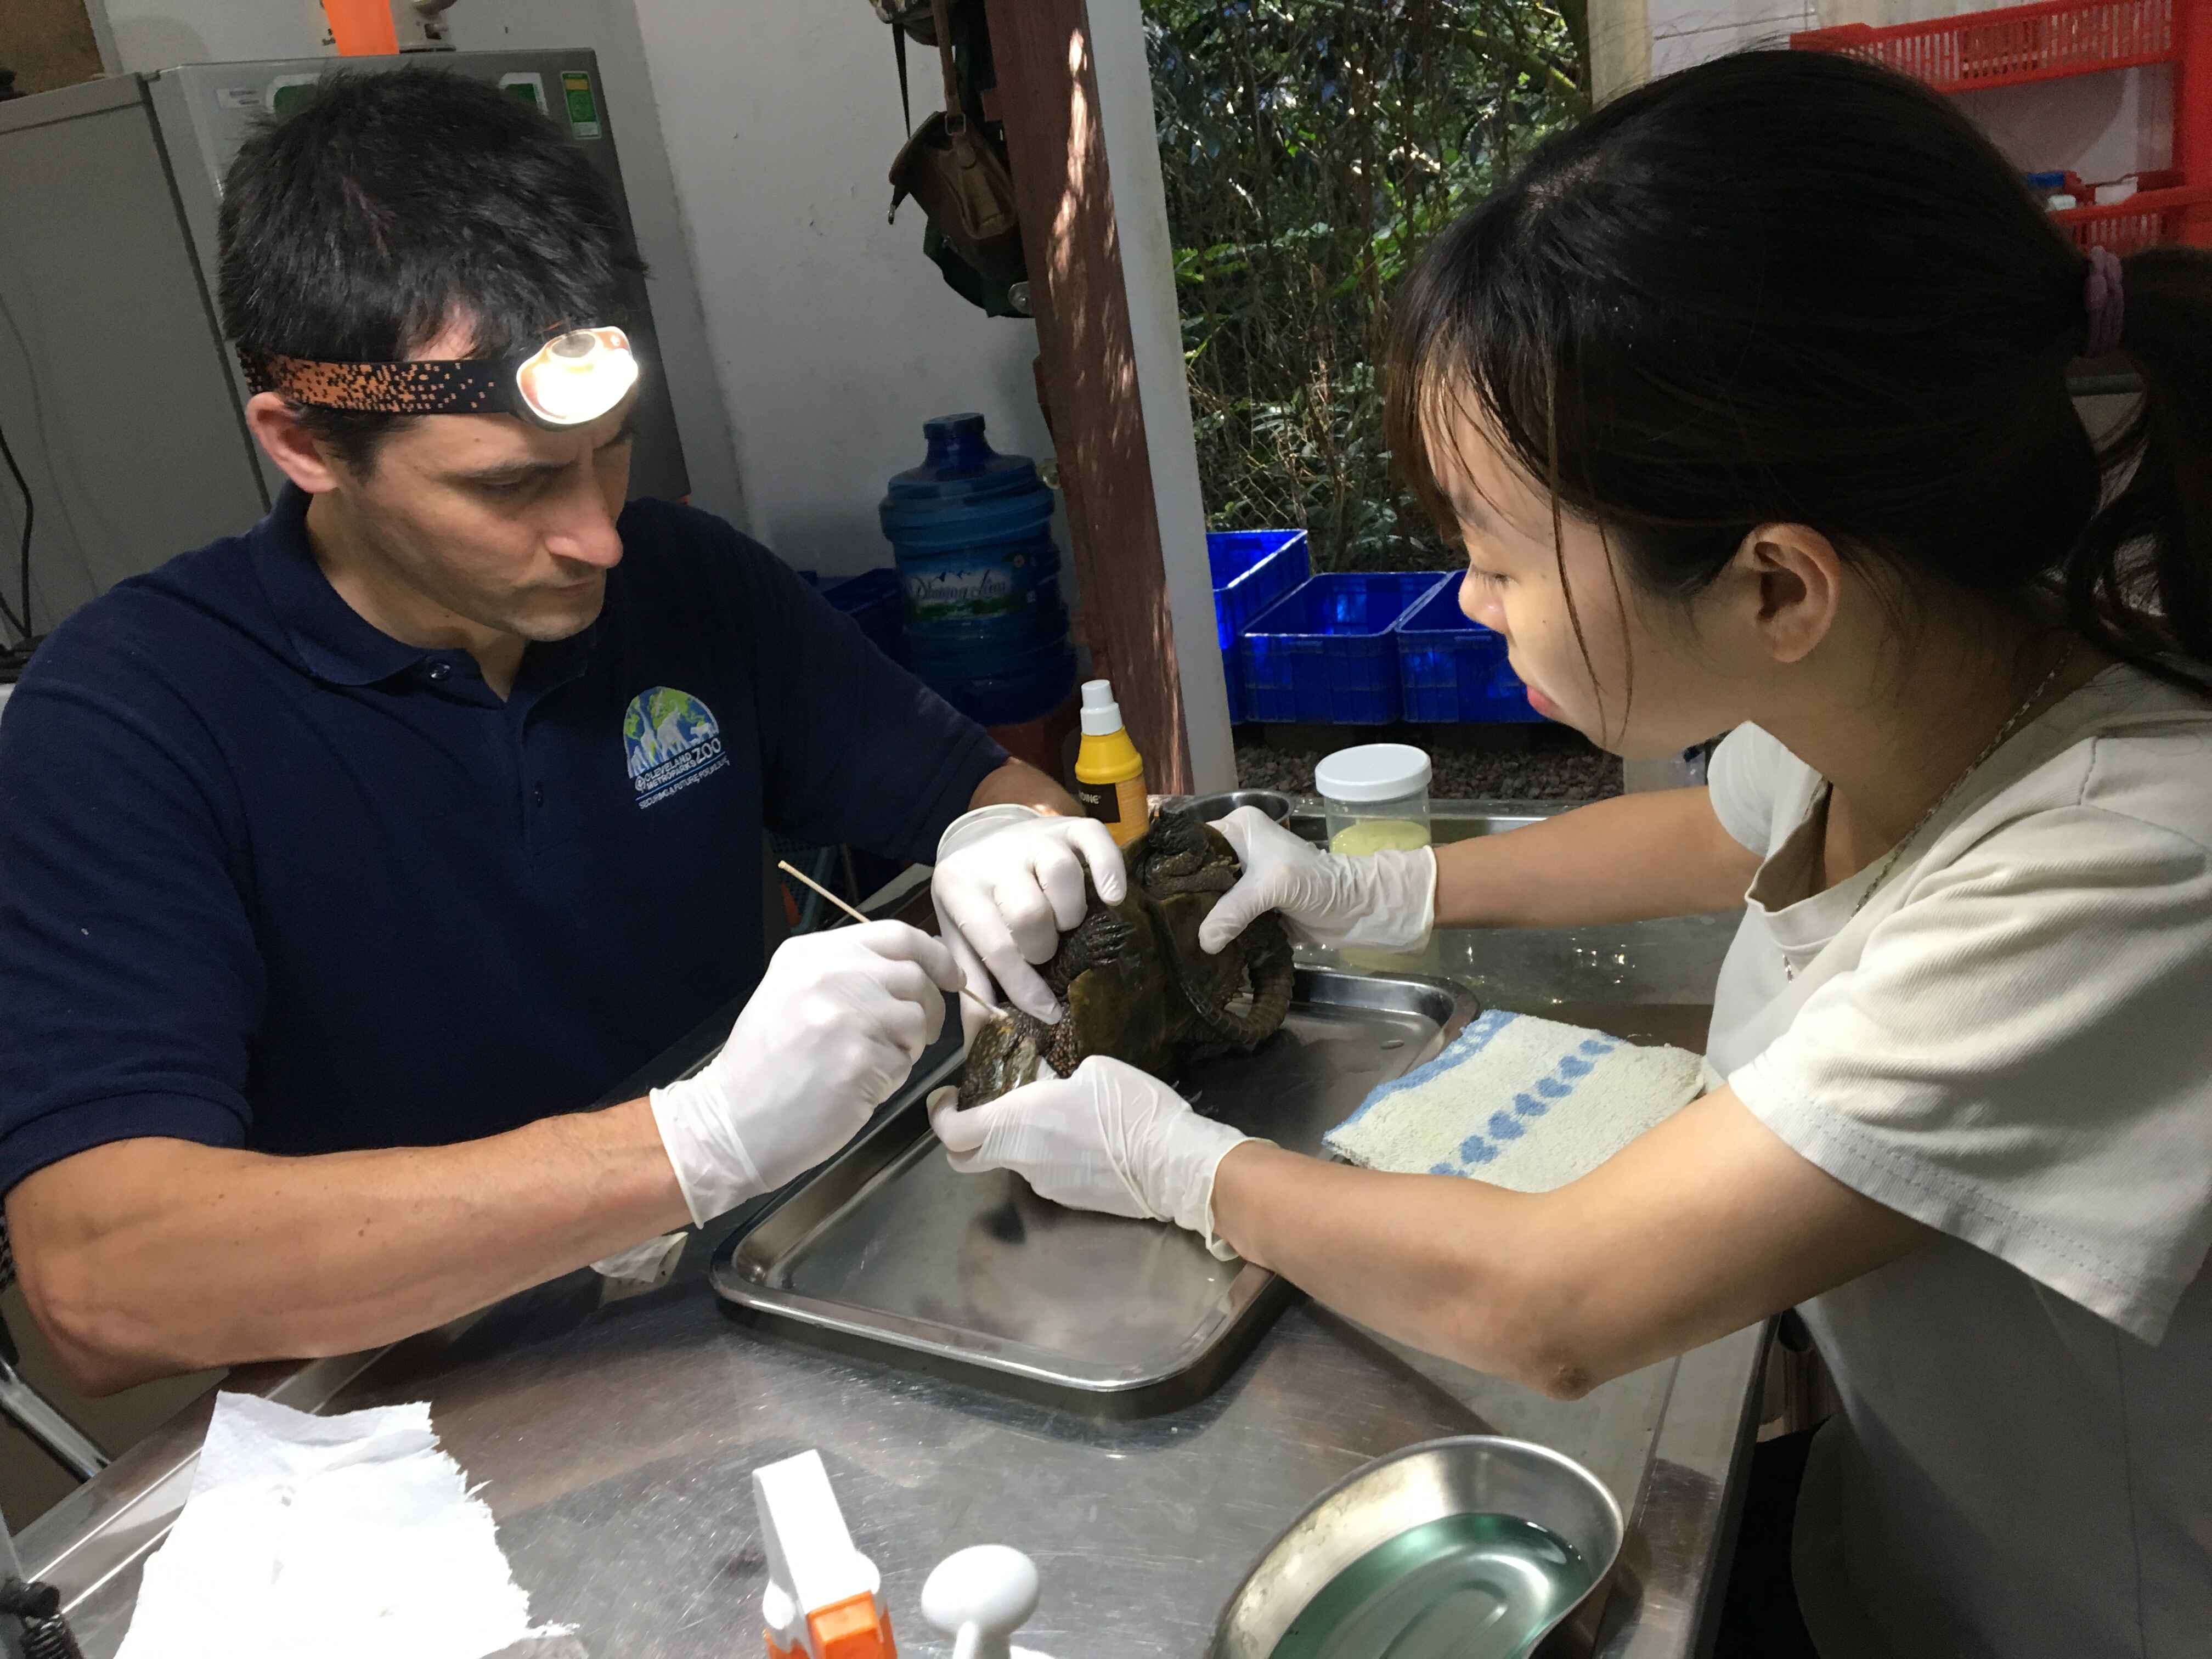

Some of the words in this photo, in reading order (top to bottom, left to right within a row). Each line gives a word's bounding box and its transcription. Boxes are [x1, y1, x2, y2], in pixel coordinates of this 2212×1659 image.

[691, 737, 721, 764] ZOO
[644, 752, 692, 782] CLEVELAND
[646, 759, 697, 789] METROPARKS
